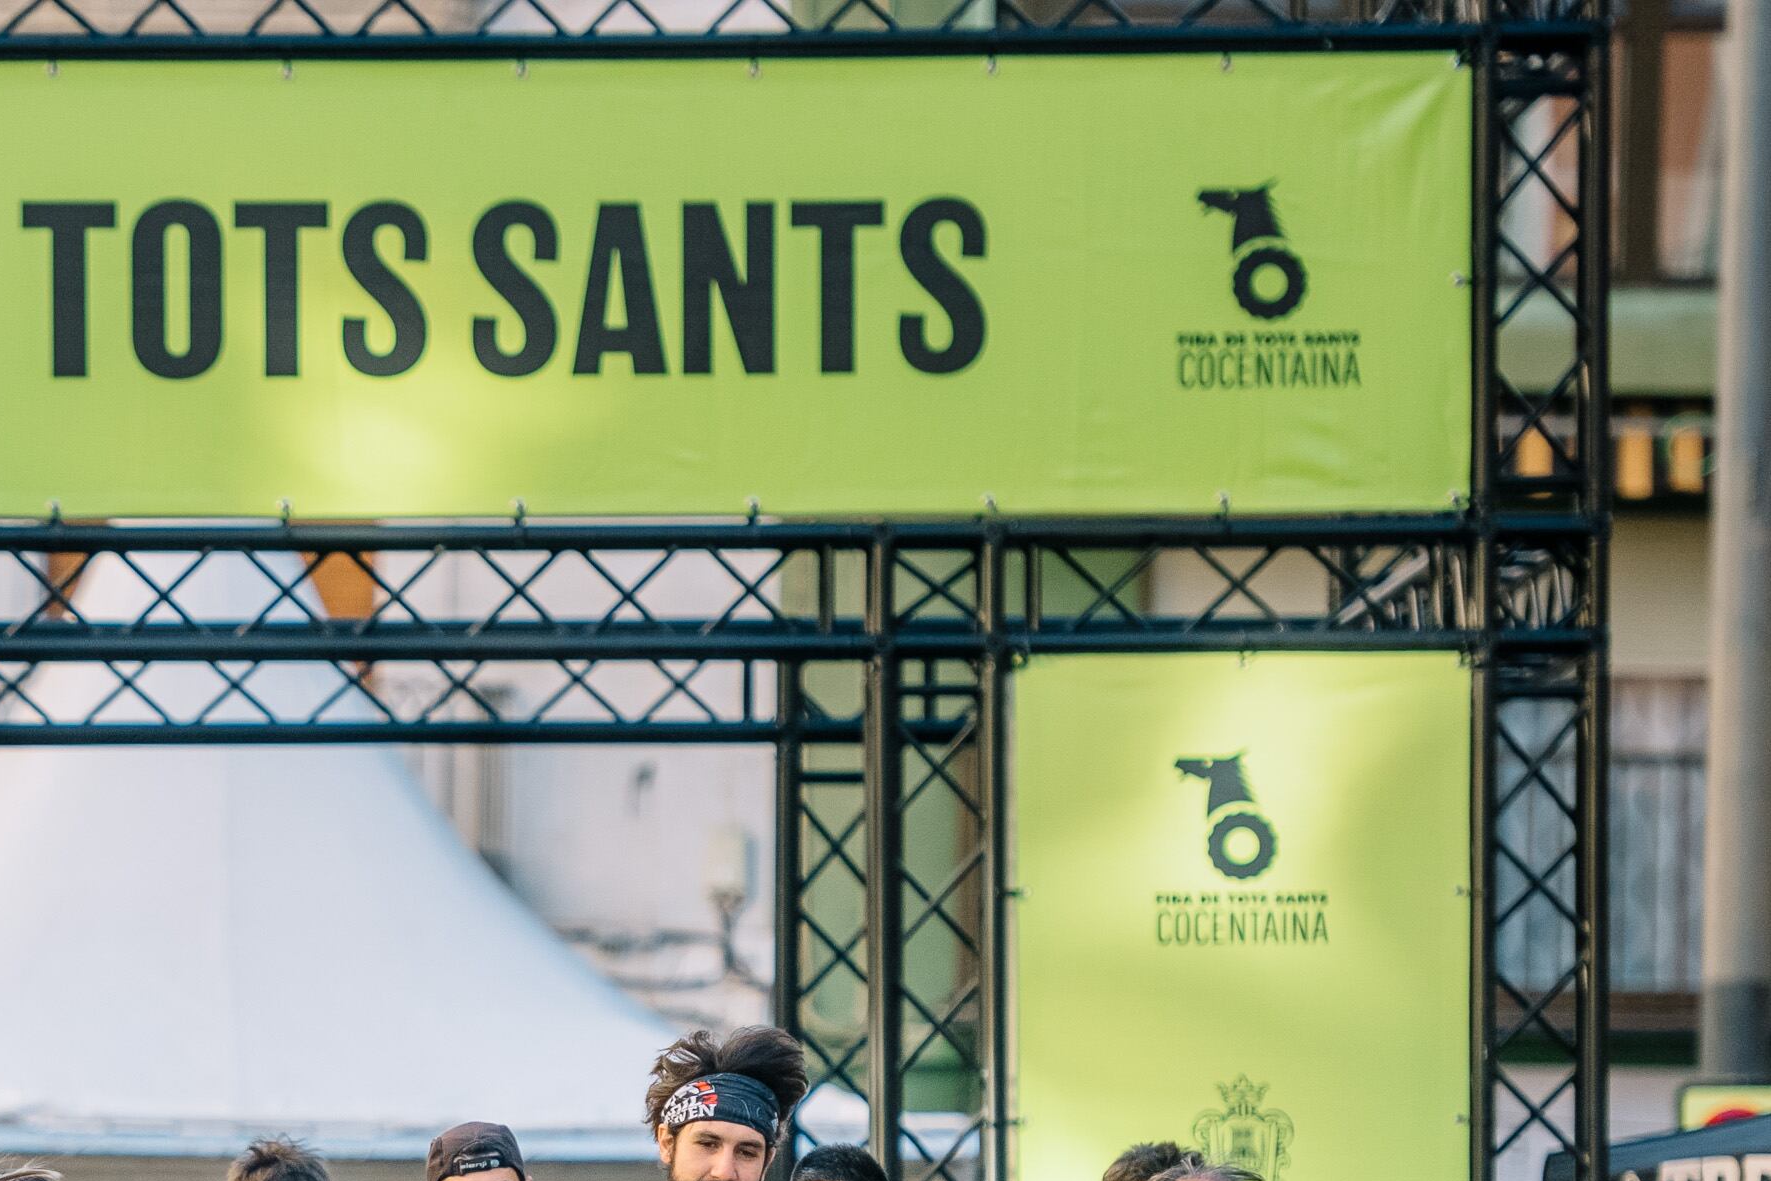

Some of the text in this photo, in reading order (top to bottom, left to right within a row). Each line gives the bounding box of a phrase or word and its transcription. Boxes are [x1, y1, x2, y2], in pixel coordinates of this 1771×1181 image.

[23, 199, 428, 379] TOTS
[472, 197, 988, 378] SANTS
[1178, 351, 1361, 388] COCENTAINA
[1157, 911, 1329, 945] COCENTAINA
